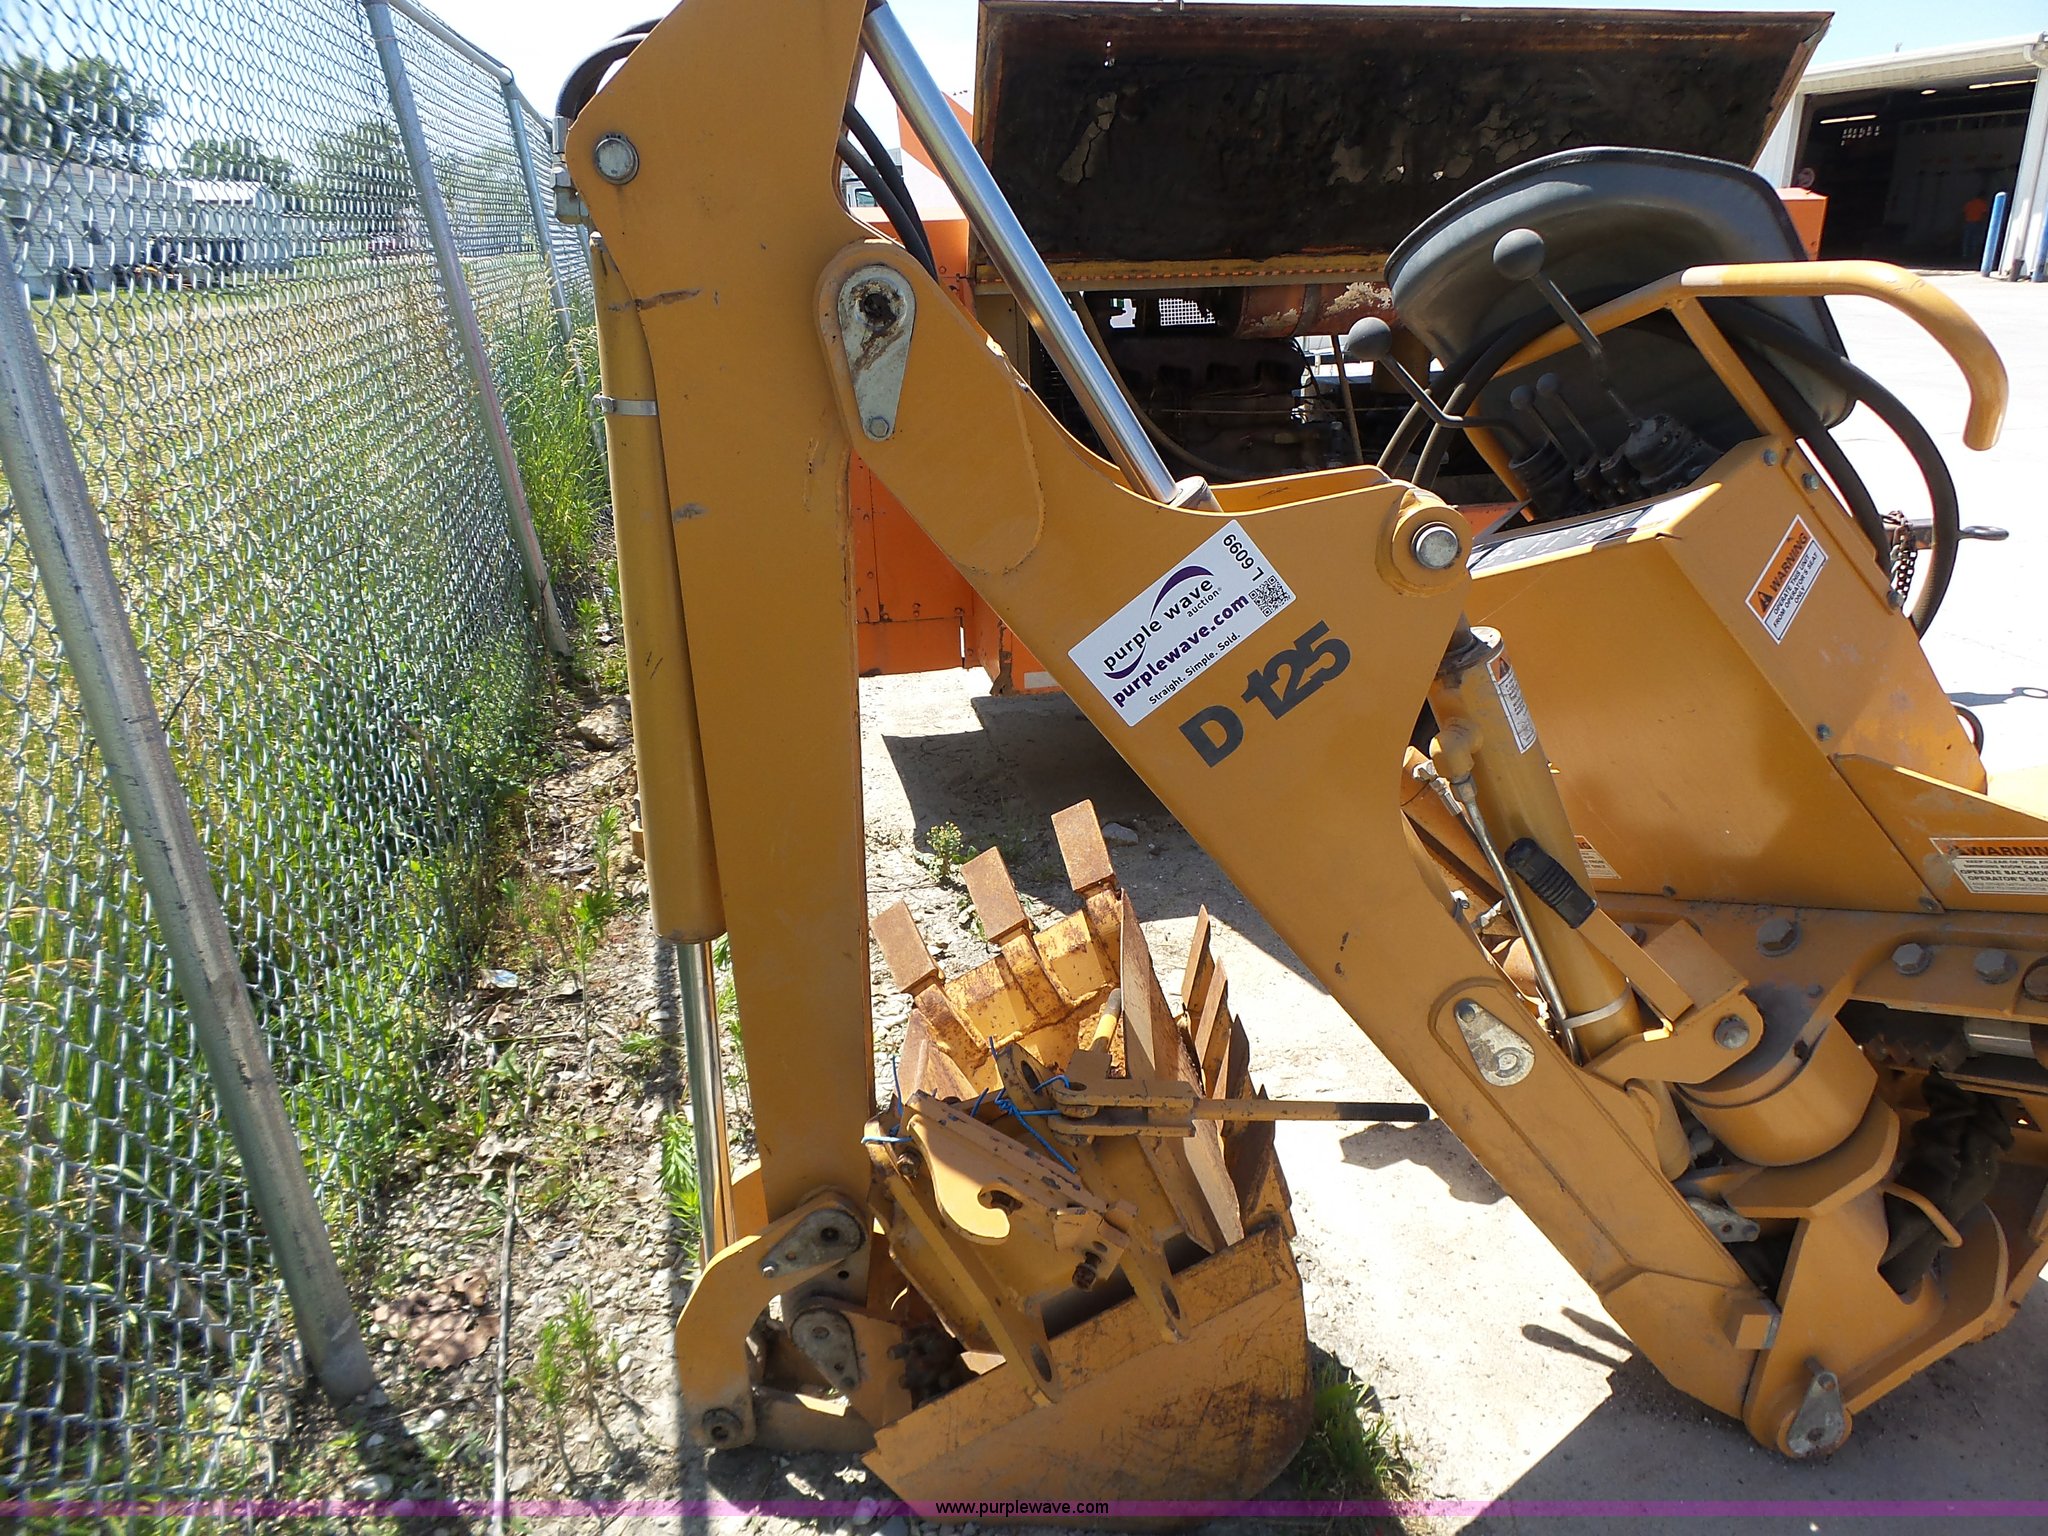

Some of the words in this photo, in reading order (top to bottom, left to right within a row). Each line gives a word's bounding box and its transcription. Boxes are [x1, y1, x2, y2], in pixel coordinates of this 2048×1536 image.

[1769, 532, 1808, 592] WARNING
[1103, 619, 1162, 671] purple
[1163, 578, 1214, 620] wave
[1186, 589, 1220, 618] auction
[1112, 595, 1250, 708] purplewave.com
[1149, 676, 1187, 705] Straight.
[1184, 651, 1219, 678] Simple.
[1217, 633, 1241, 653] Sold.
[1178, 705, 1244, 768] D
[1240, 619, 1351, 721] 125
